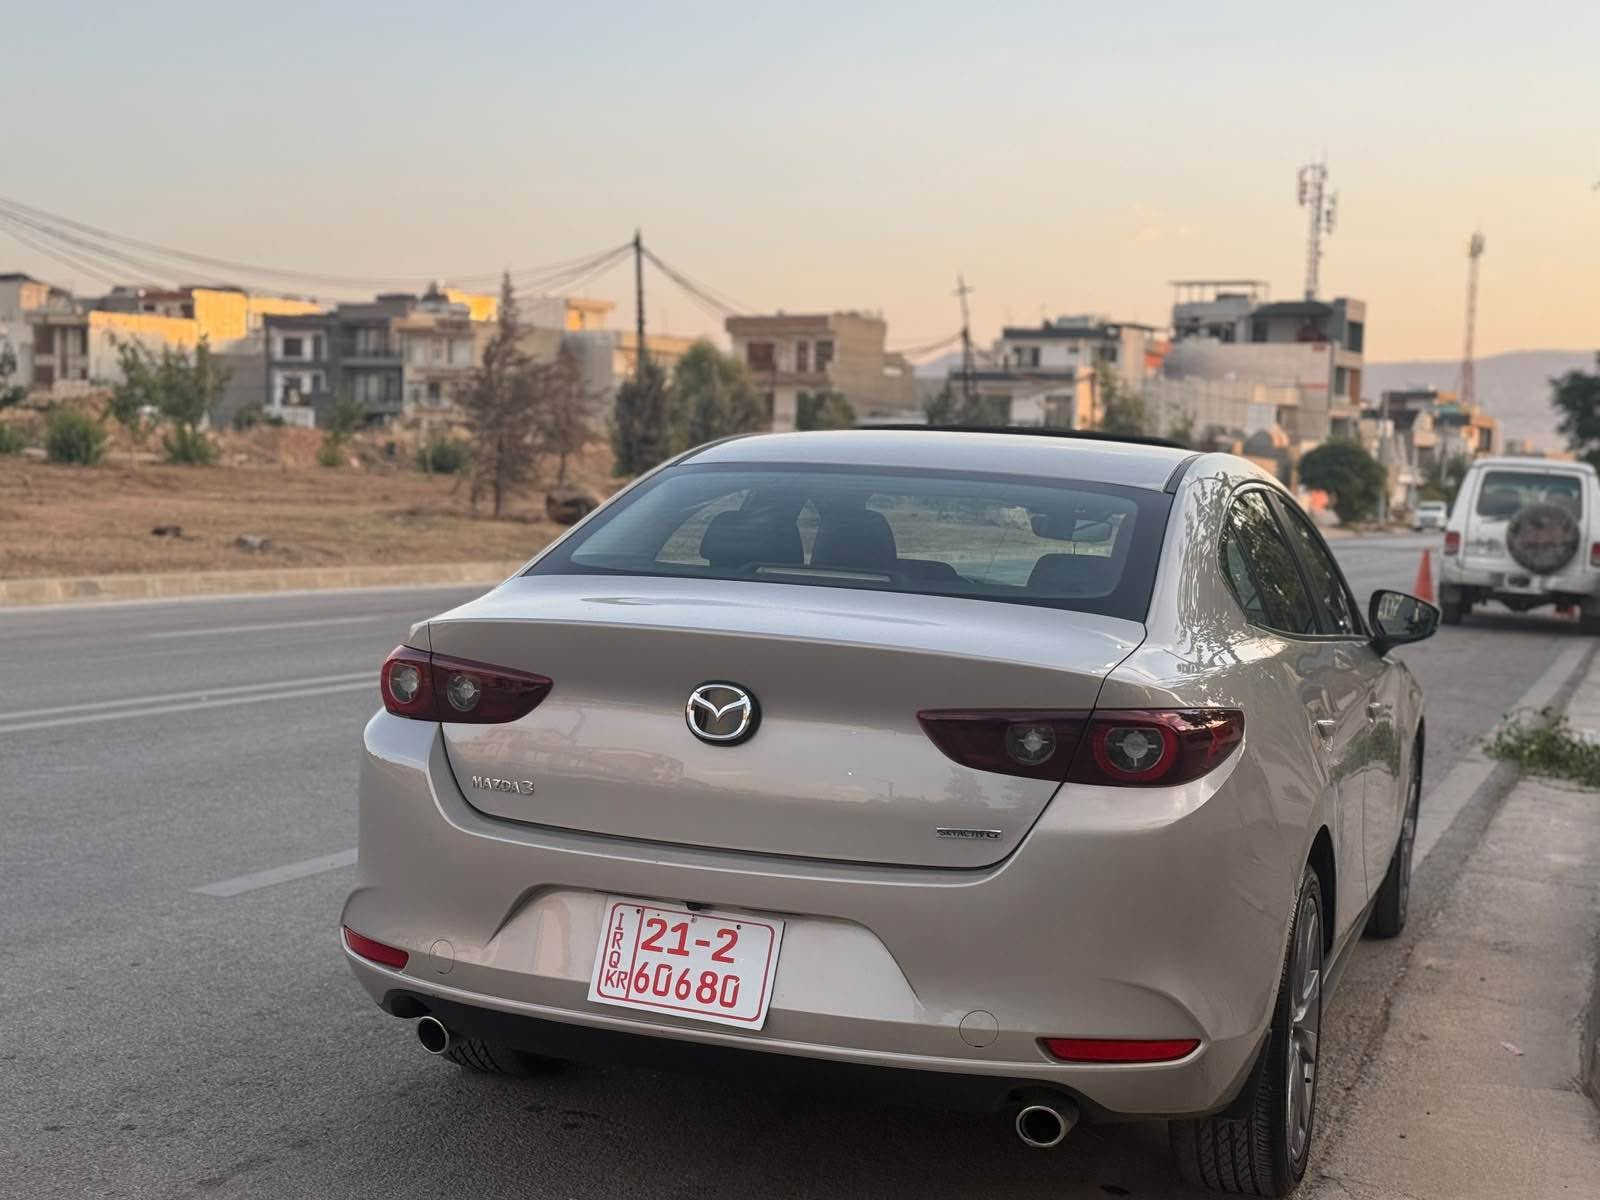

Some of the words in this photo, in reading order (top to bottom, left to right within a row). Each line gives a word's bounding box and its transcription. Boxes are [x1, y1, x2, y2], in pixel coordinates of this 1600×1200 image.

[641, 917, 739, 964] 21-2
[604, 969, 628, 990] KR
[633, 961, 741, 1009] 60680
